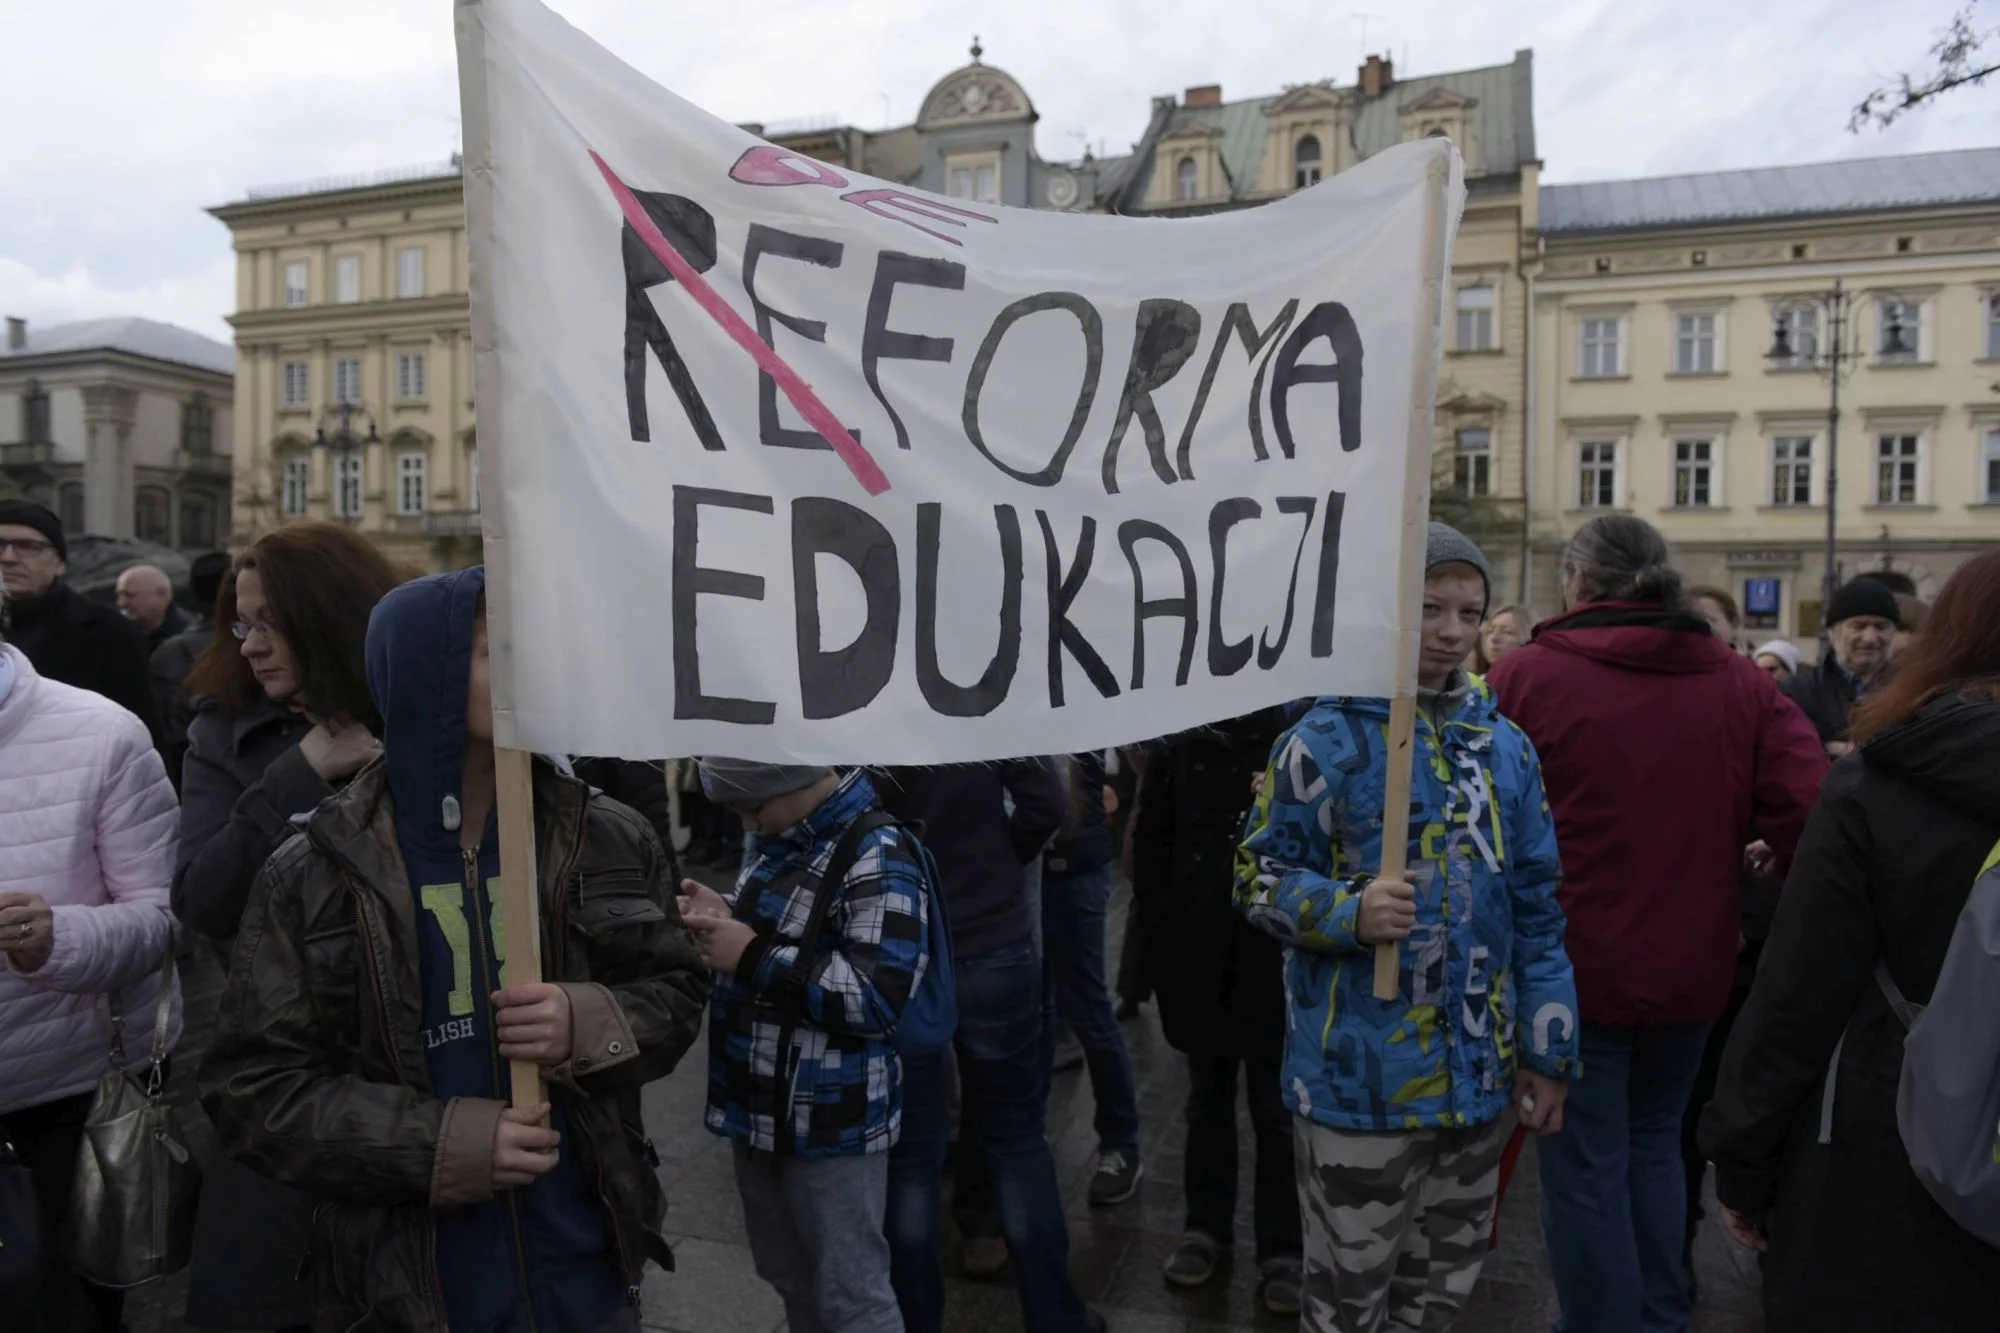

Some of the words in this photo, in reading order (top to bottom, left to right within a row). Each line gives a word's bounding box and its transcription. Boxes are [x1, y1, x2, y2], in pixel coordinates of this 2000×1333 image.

[622, 187, 1364, 493] REFORMA
[673, 485, 1346, 725] EDUKACJI
[424, 1018, 474, 1049] LISH
